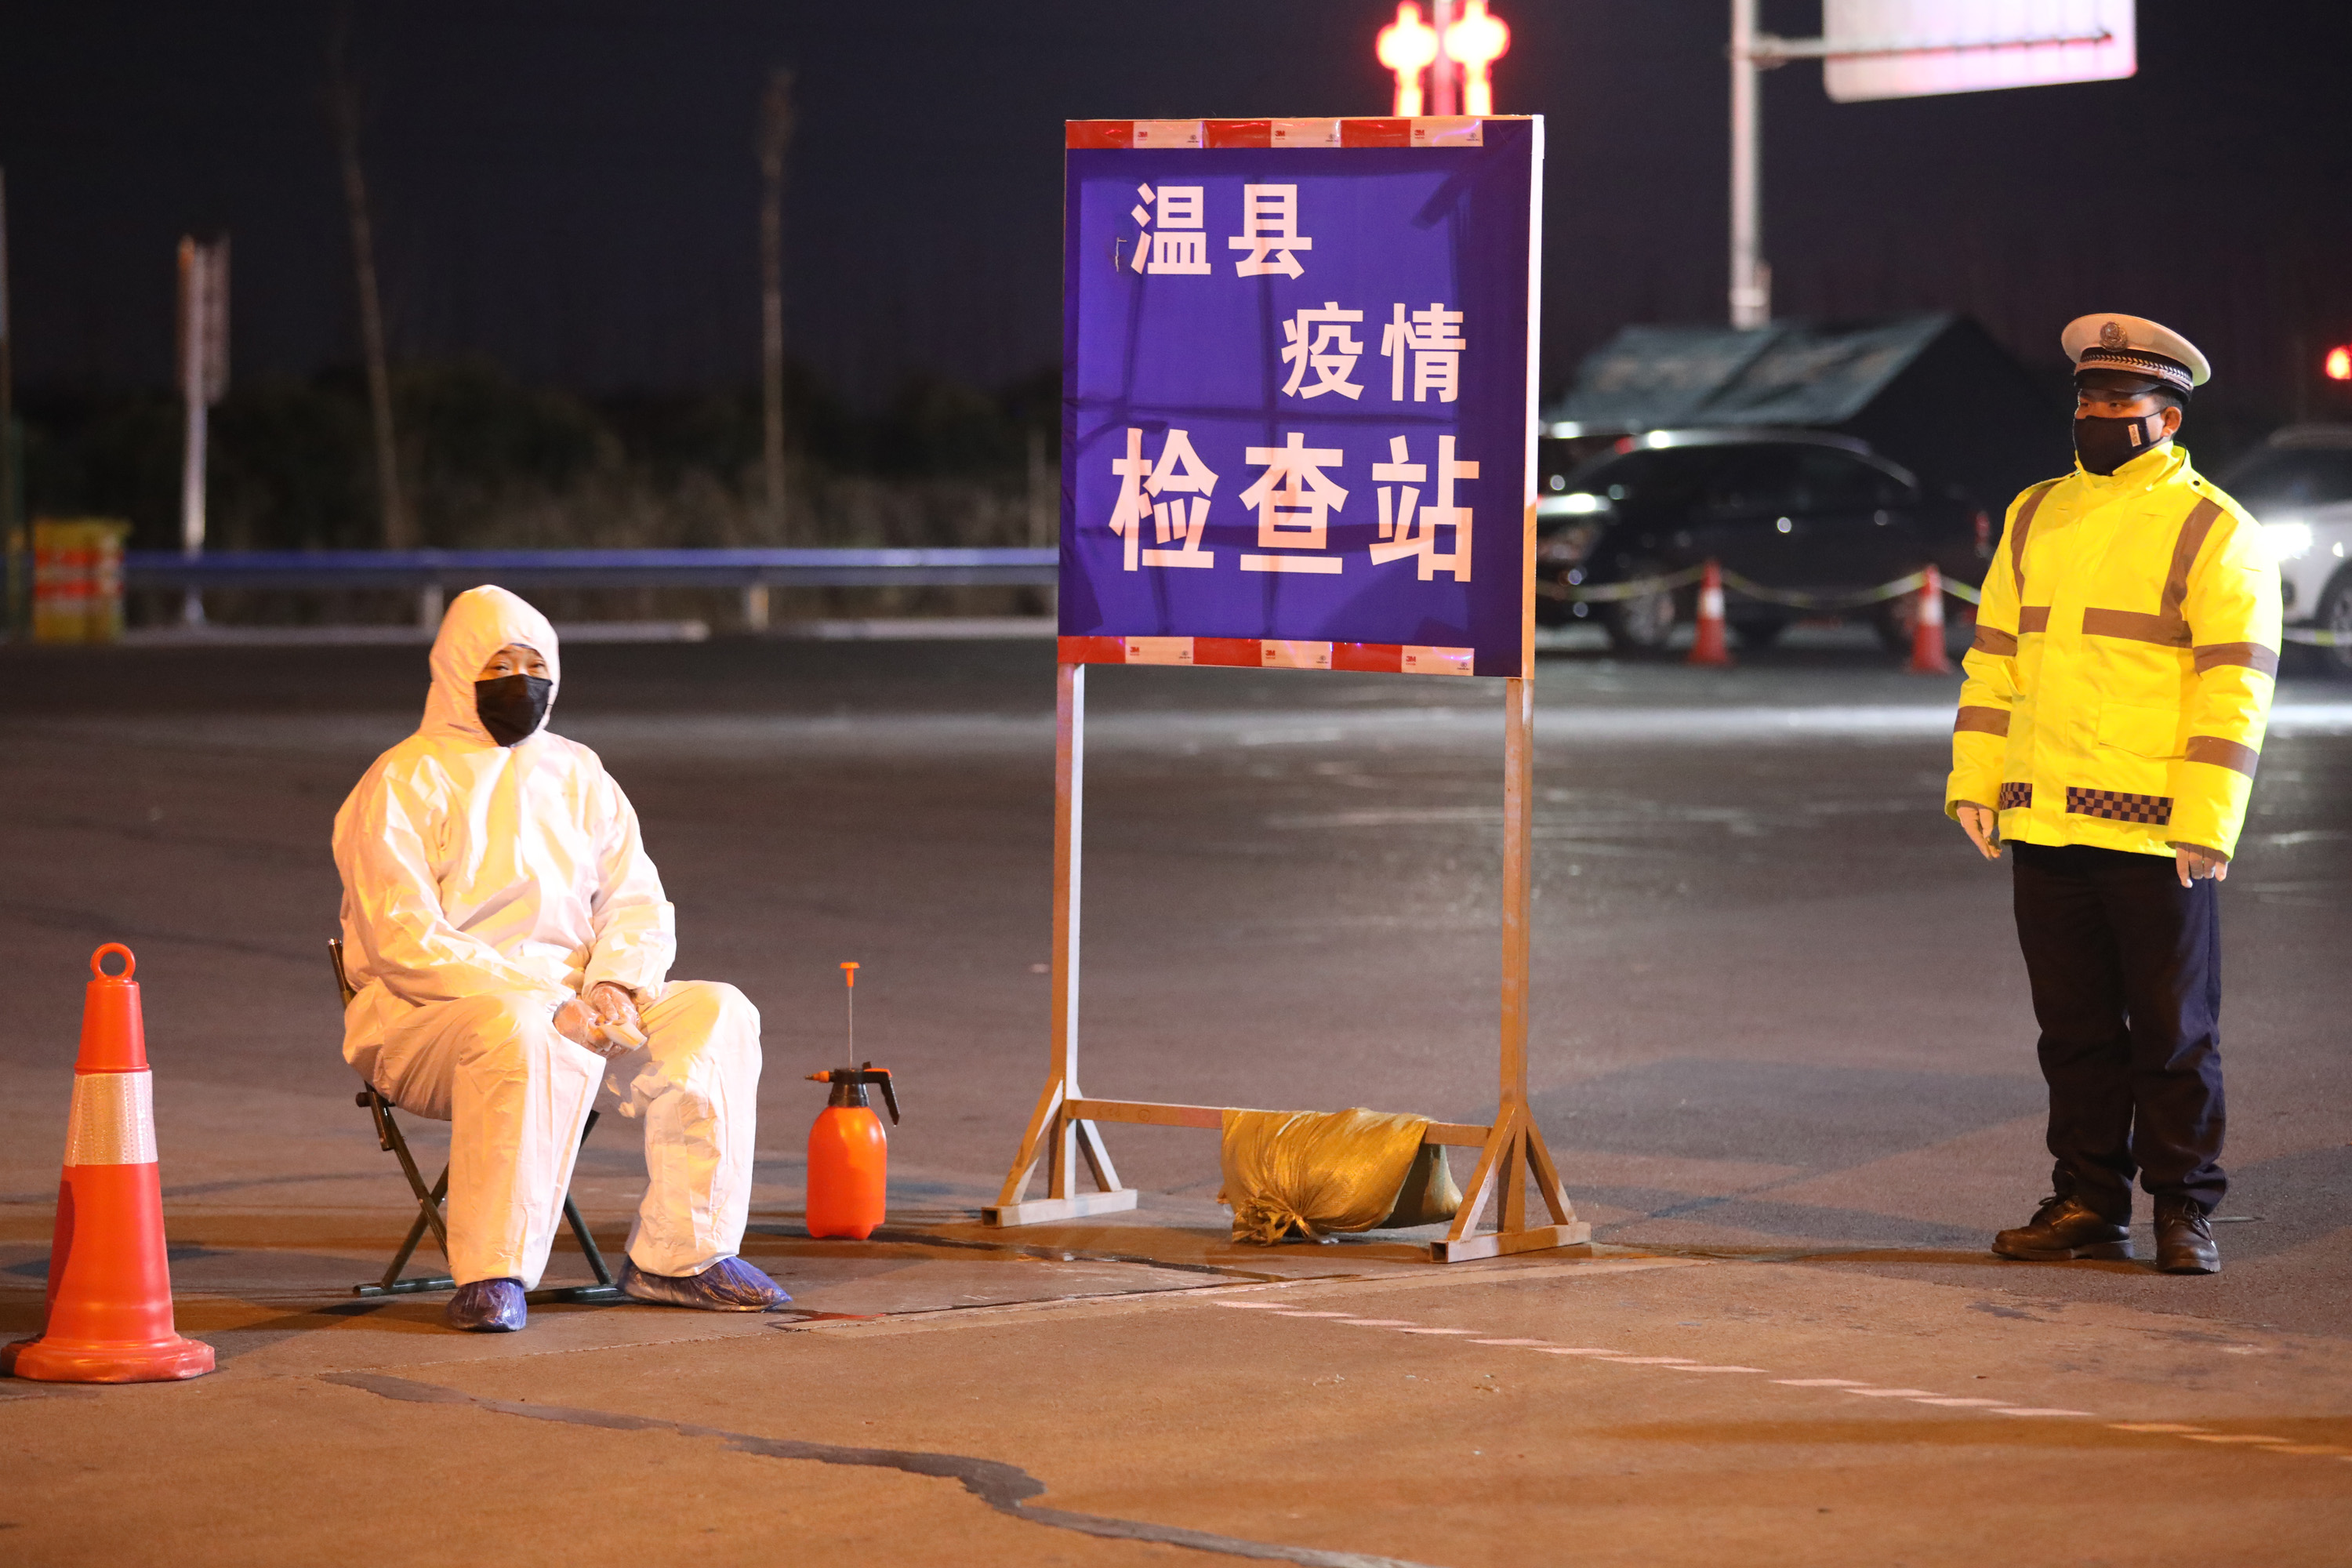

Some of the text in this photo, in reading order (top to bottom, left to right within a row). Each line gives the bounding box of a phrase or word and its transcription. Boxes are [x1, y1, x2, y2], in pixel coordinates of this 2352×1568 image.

[1131, 182, 1312, 280] 温县
[1281, 301, 1466, 403] 疫情
[1109, 427, 1480, 583] 检查站
